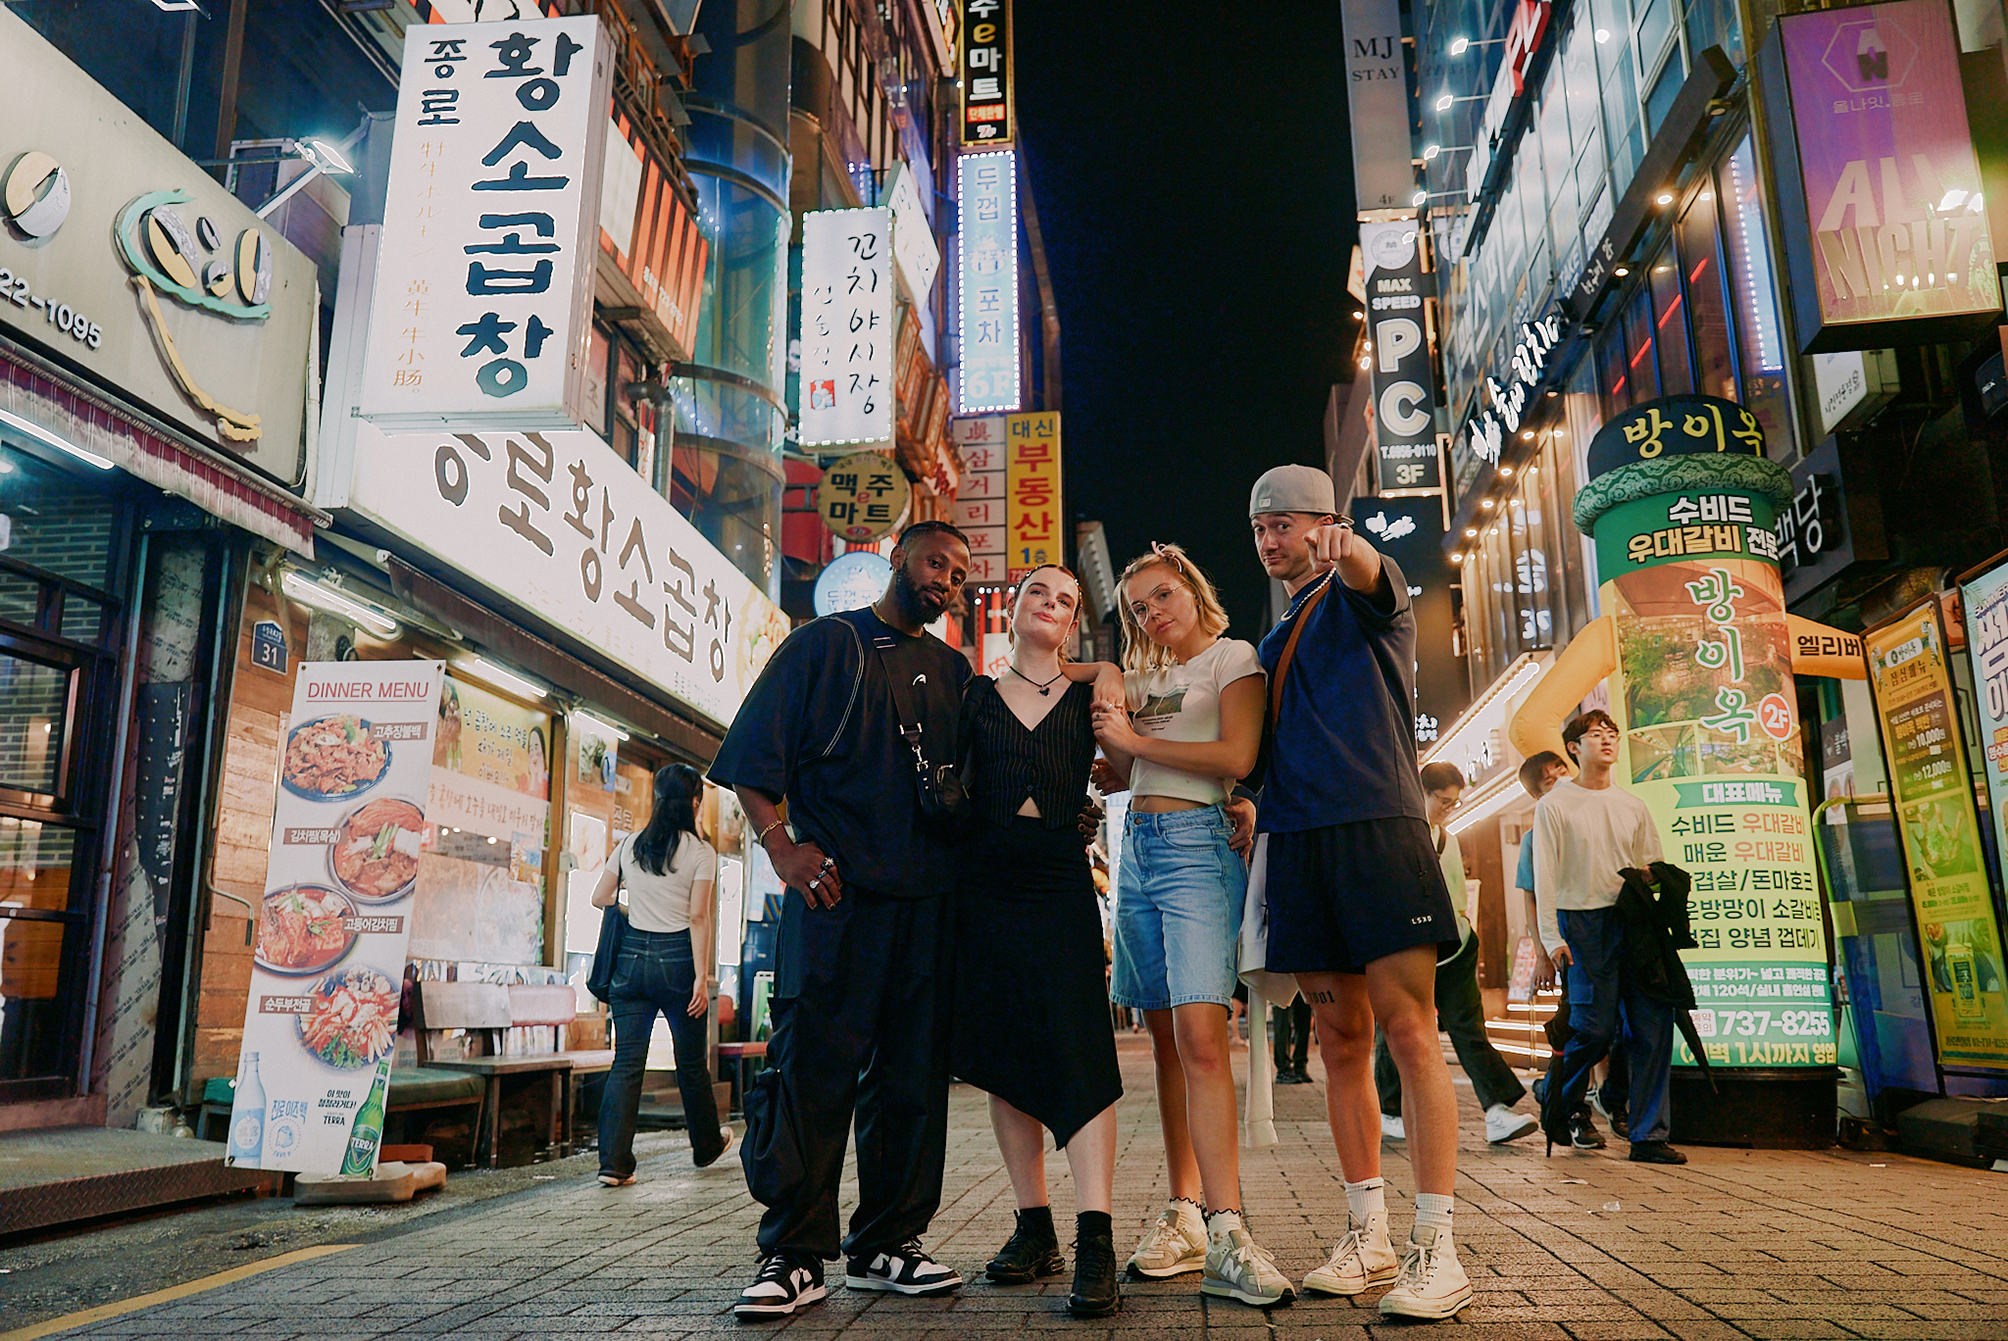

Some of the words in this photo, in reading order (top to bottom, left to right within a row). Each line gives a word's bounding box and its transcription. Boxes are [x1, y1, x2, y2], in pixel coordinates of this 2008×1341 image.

[1353, 36, 1395, 59] MJ
[417, 39, 468, 126] 종로
[1352, 66, 1400, 82] STAY
[976, 167, 999, 221] 두껍
[455, 31, 584, 399] 황소곱창
[1377, 278, 1413, 292] MAX
[1371, 295, 1422, 311] SPEED
[978, 288, 1002, 344] 포차
[967, 370, 1012, 399] 6F
[1376, 317, 1432, 437] PC
[1012, 419, 1054, 439] 대신
[1622, 403, 1764, 459] 방이옥
[831, 473, 895, 498] 맥주
[1396, 464, 1425, 485] 3F
[1014, 444, 1054, 542] 부동산
[829, 502, 893, 525] 마트
[1668, 495, 1754, 525] 수비드
[1627, 525, 1742, 564] 우대갈비
[261, 643, 278, 666] 31
[1684, 567, 1757, 745] 방이옥
[308, 682, 373, 699] DINNER
[378, 681, 429, 699] MENU
[1764, 703, 1789, 729] 2F
[1702, 782, 1783, 804] 대표메뉴
[1671, 813, 1736, 837] 수비드
[1743, 812, 1806, 836] 우대갈비
[1684, 841, 1727, 863] 매운
[1735, 841, 1805, 863] 우대갈비
[1689, 869, 1813, 892] 겹살/돈마호크
[1728, 927, 1772, 949] 양념
[1778, 927, 1820, 950] 껍데기
[1713, 967, 1759, 982] 분위기~
[1760, 967, 1784, 981] 넓고
[1718, 1010, 1831, 1036] 737-8255
[1735, 1041, 1810, 1064] 1시까지
[323, 1115, 346, 1127] TERRA
[350, 1136, 375, 1152] TERRA
